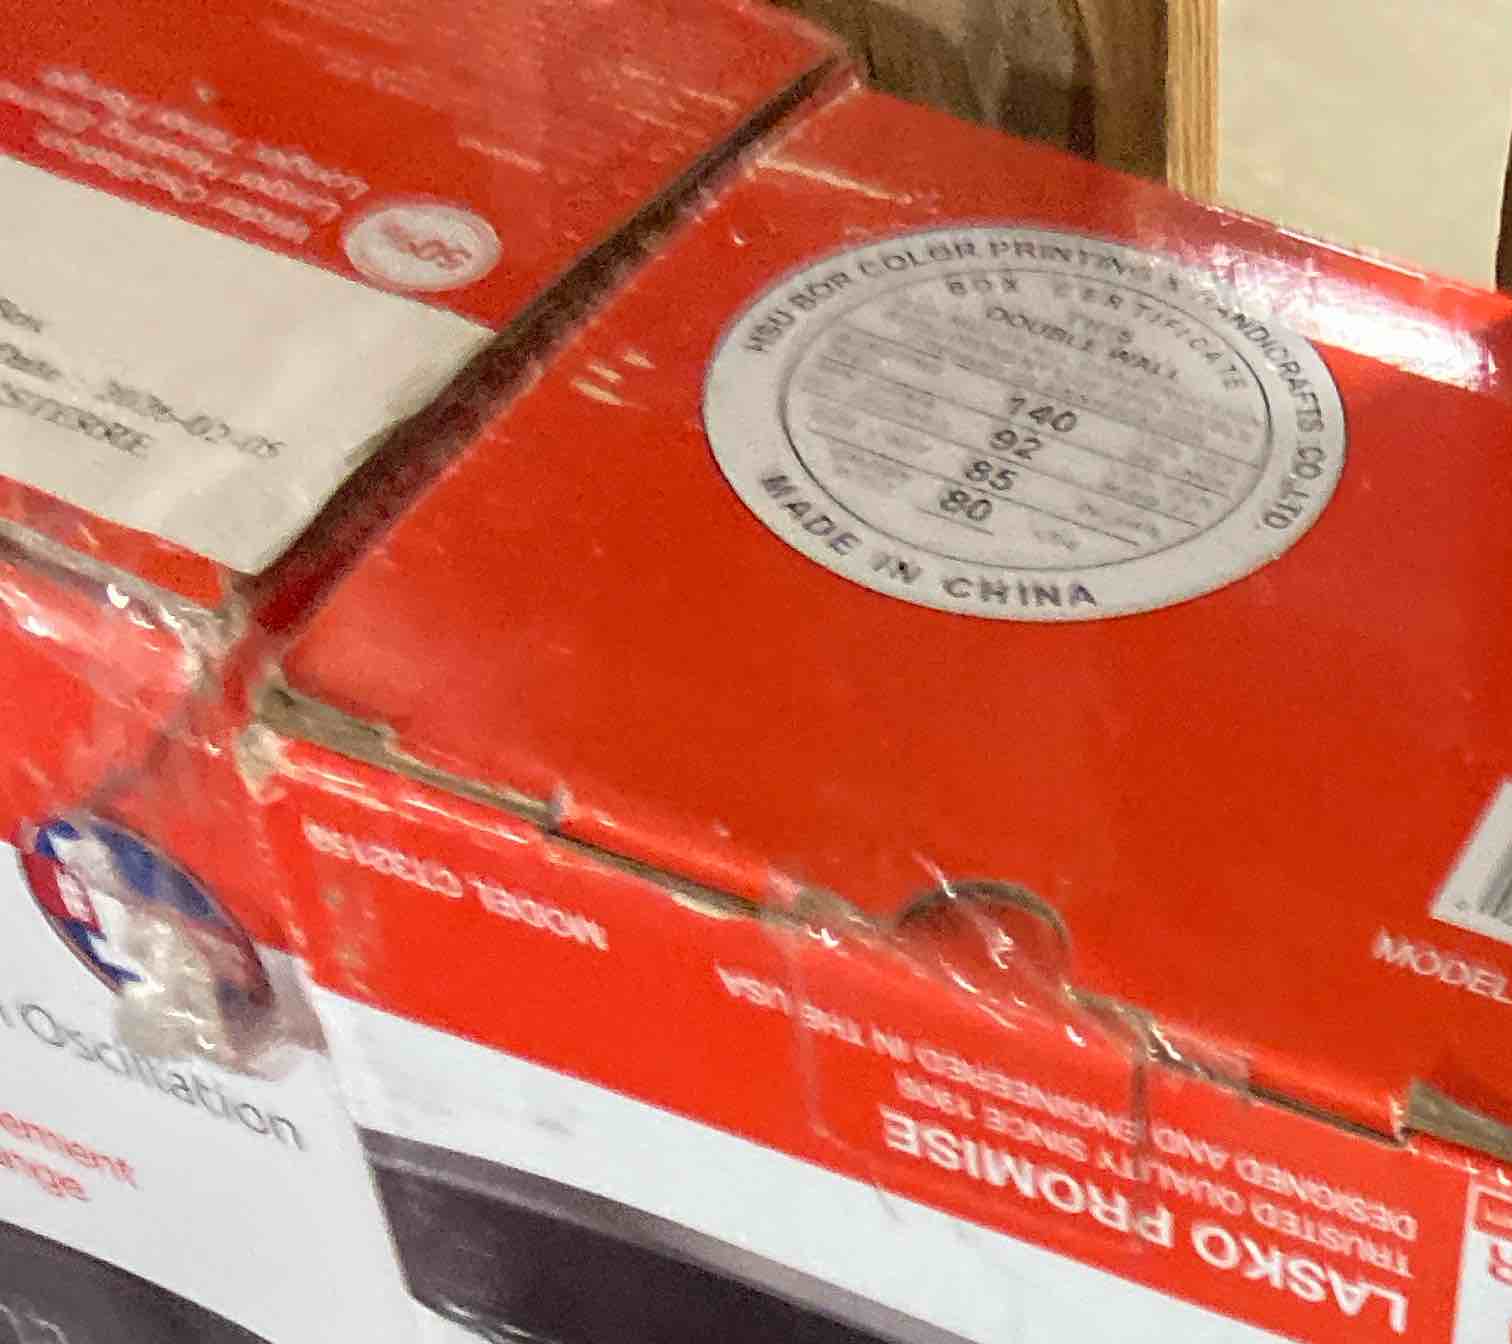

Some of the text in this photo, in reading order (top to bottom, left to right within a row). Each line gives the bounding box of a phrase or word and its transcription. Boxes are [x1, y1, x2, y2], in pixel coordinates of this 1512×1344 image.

[858, 240, 977, 278] COLOR
[1198, 290, 1324, 433] ANDICRAFTS
[989, 428, 1041, 460] 92
[1005, 396, 1077, 433] 140
[939, 490, 993, 522] 80
[964, 459, 1017, 491] 85
[760, 474, 1097, 606] MADE IN CHINA
[470, 877, 609, 950] MODEL
[1370, 927, 1512, 1004] MODEL
[714, 962, 1419, 1242] DESIGNED AND ENGINEERED IN THE USA
[984, 1103, 1088, 1163] SINCE
[879, 1103, 1176, 1249] PROMISE
[1098, 1148, 1246, 1217] QUALITY
[1251, 1200, 1414, 1279] TRUSTED
[1190, 1220, 1409, 1335] LASKO
